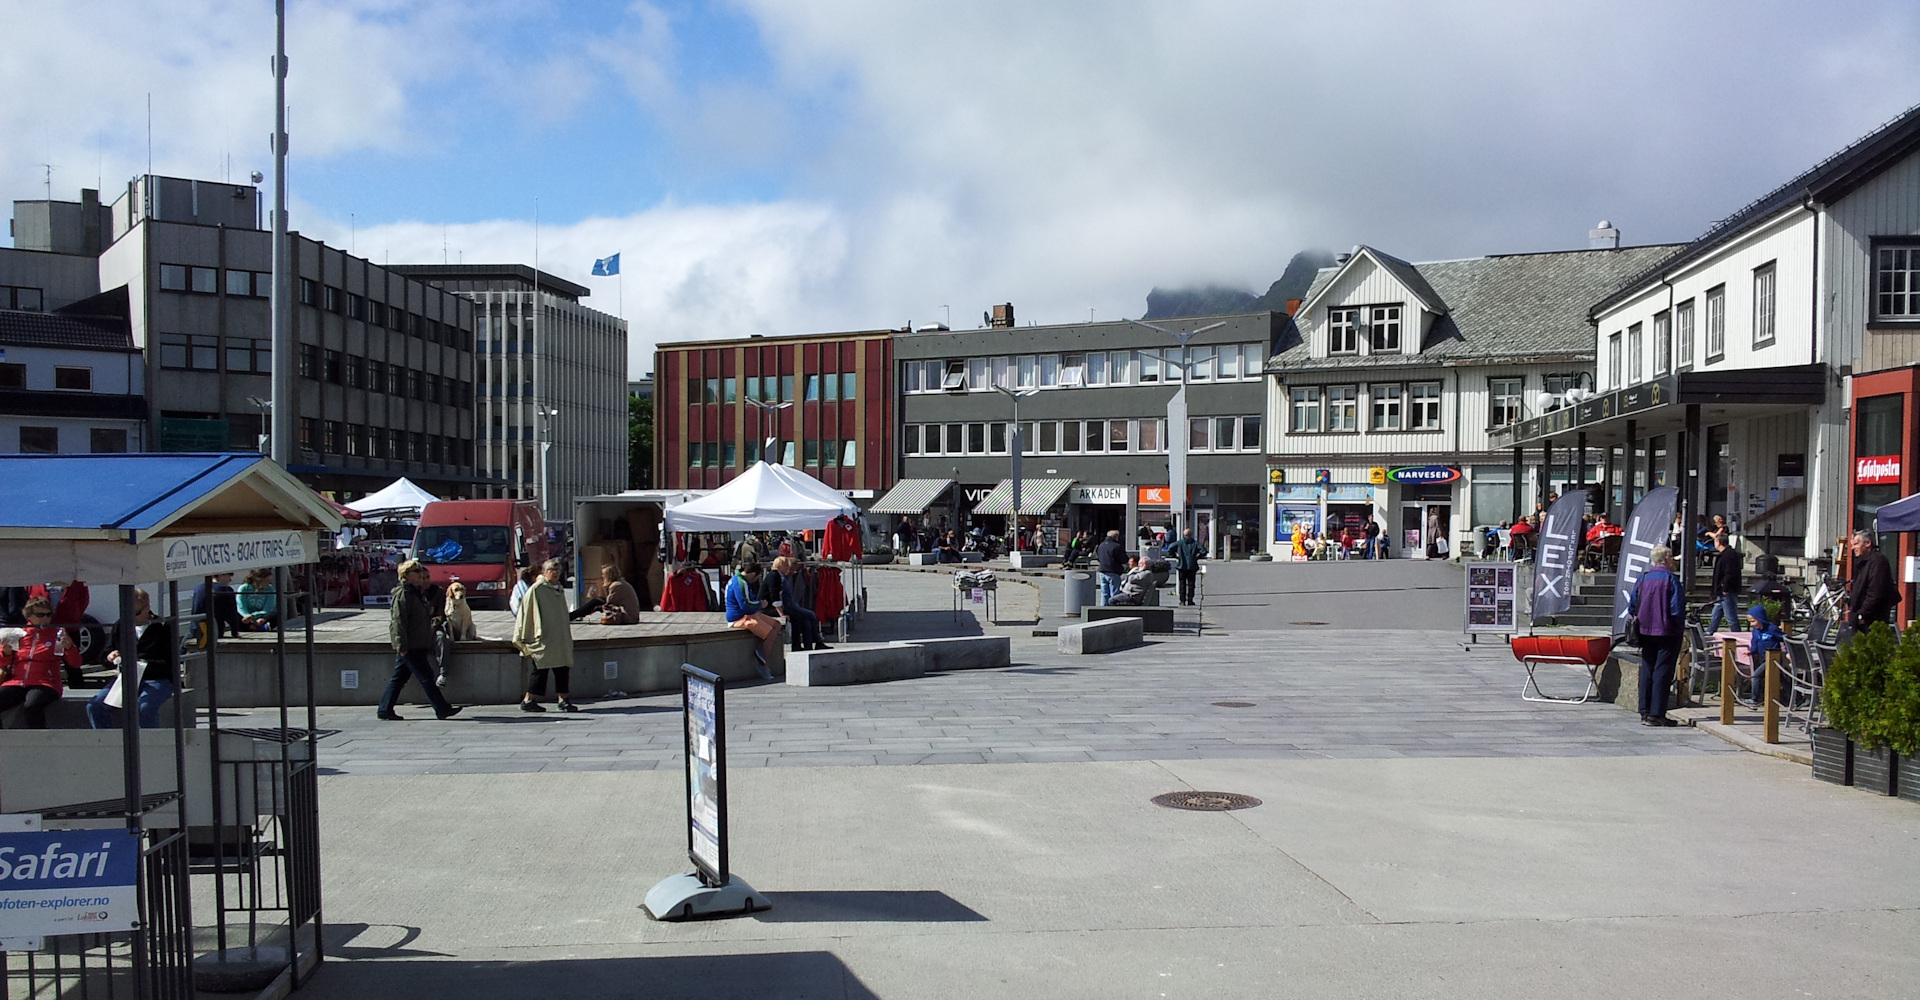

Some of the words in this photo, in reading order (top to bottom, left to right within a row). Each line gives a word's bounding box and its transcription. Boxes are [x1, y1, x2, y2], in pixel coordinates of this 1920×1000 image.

[1397, 471, 1449, 479] NARVESEN
[1857, 458, 1900, 482] Lofotposten
[1079, 488, 1121, 500] ARKADEN
[191, 543, 231, 566] TICKETS
[237, 541, 261, 562] BOAT
[262, 539, 284, 559] TRIPS
[1537, 514, 1568, 598] LEX
[166, 559, 187, 574] explorer
[0, 841, 111, 880] Safari
